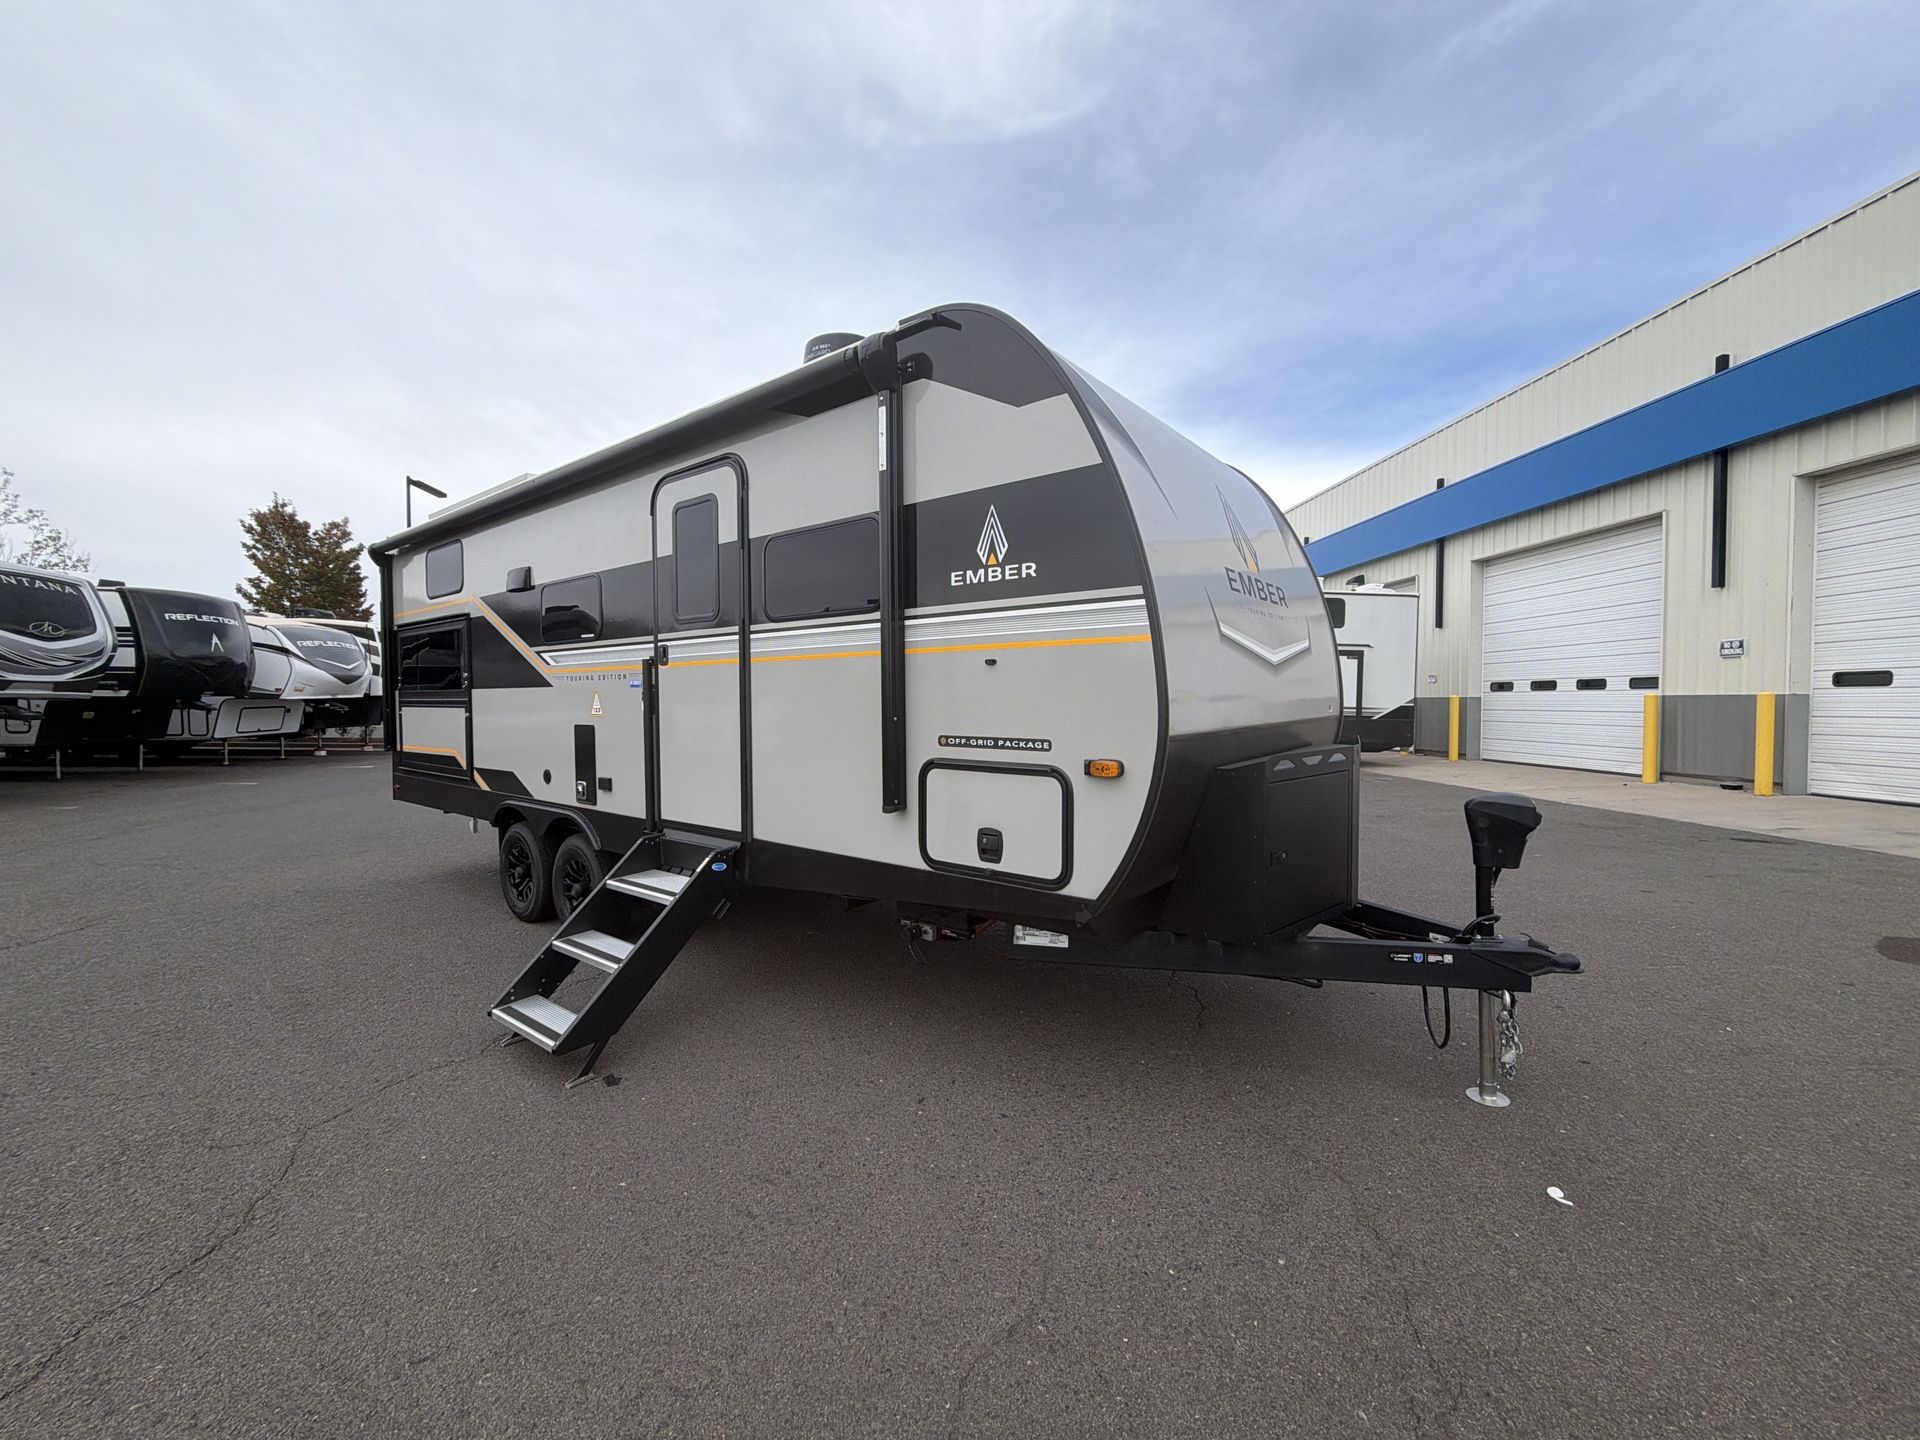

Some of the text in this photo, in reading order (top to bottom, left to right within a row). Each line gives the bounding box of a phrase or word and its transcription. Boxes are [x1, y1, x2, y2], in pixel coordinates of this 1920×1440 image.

[950, 562, 1037, 586] EMBER
[1224, 566, 1288, 608] EMBER
[164, 613, 239, 626] REFLECTION
[1723, 641, 1731, 649] NO
[598, 673, 628, 681] EDITION
[948, 738, 1050, 749] OFF-GRID PACKAGE
